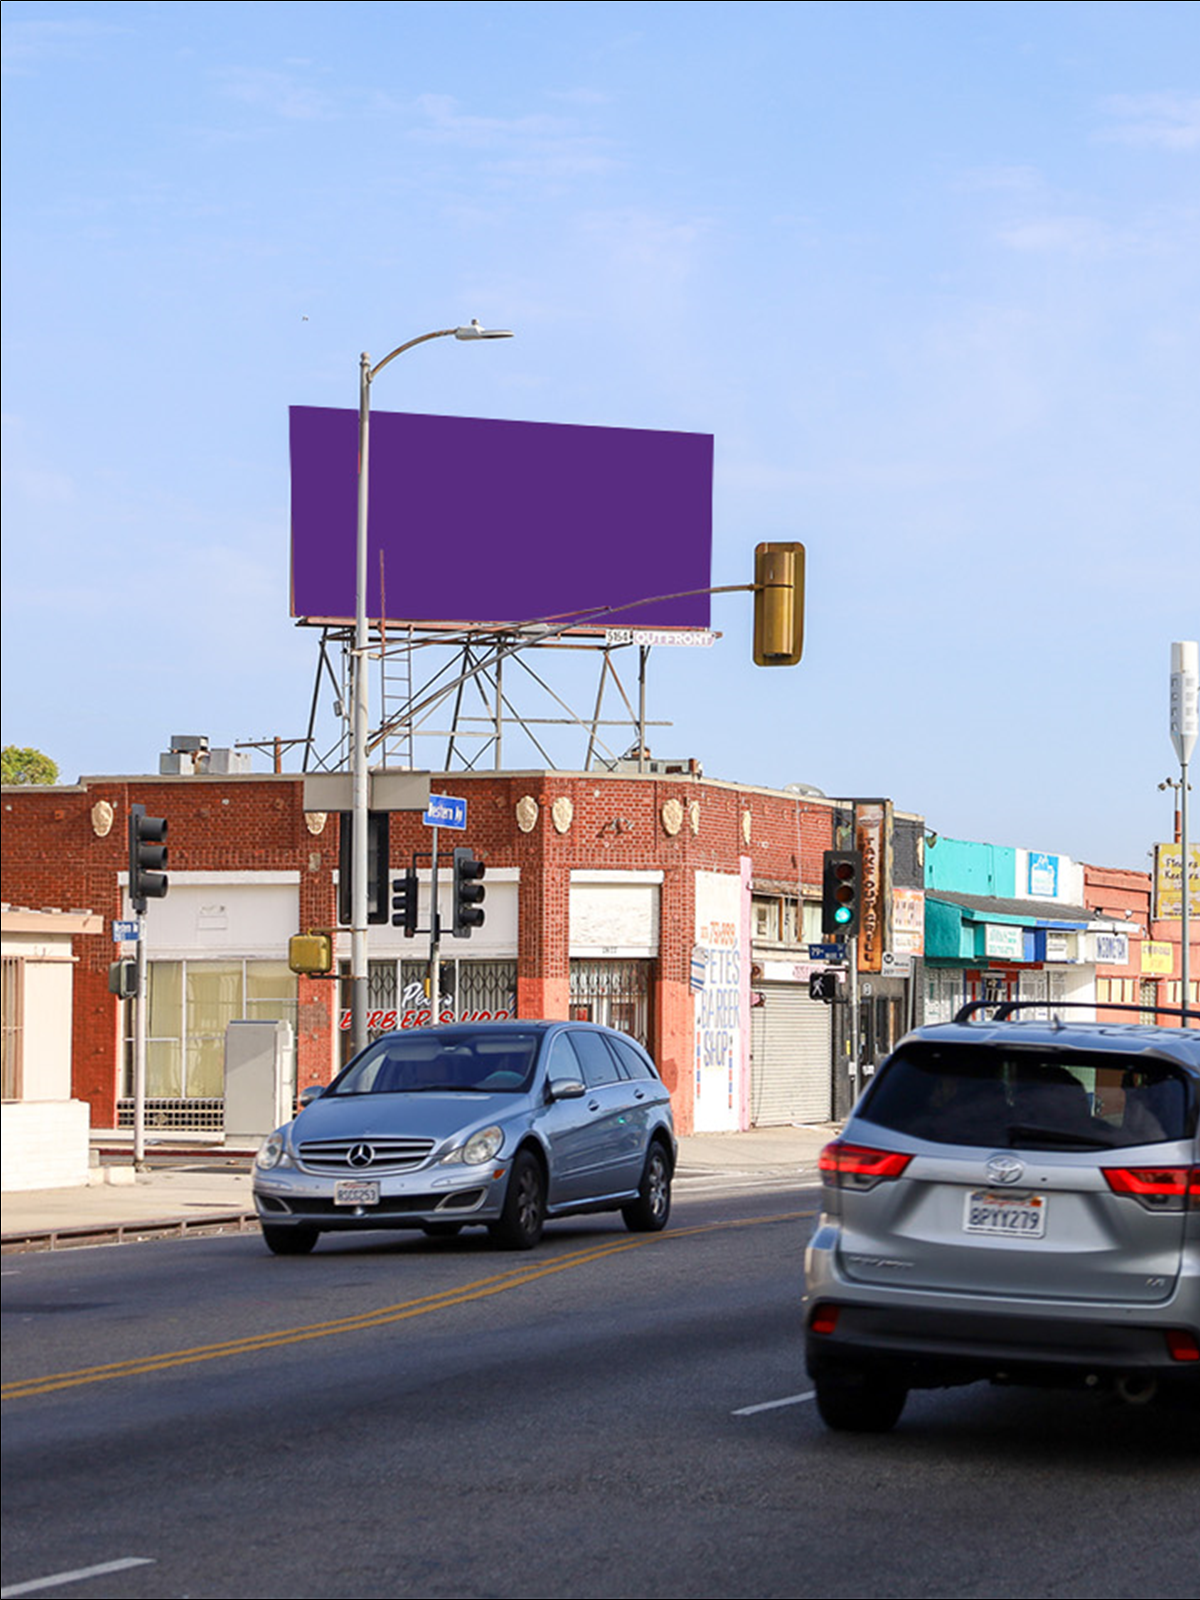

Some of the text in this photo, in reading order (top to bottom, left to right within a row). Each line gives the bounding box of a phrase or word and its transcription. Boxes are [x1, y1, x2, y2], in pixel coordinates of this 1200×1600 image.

[634, 632, 711, 646] OUTFRONT
[864, 837, 875, 875] TAKE
[1166, 858, 1199, 869] Finrs
[1164, 871, 1199, 880] Keers
[864, 881, 876, 907] OUT
[340, 1010, 432, 1030] BRBER
[701, 988, 740, 1029] BARBER
[703, 1030, 728, 1067] SHOP
[970, 1207, 1040, 1230] 8PYY279
